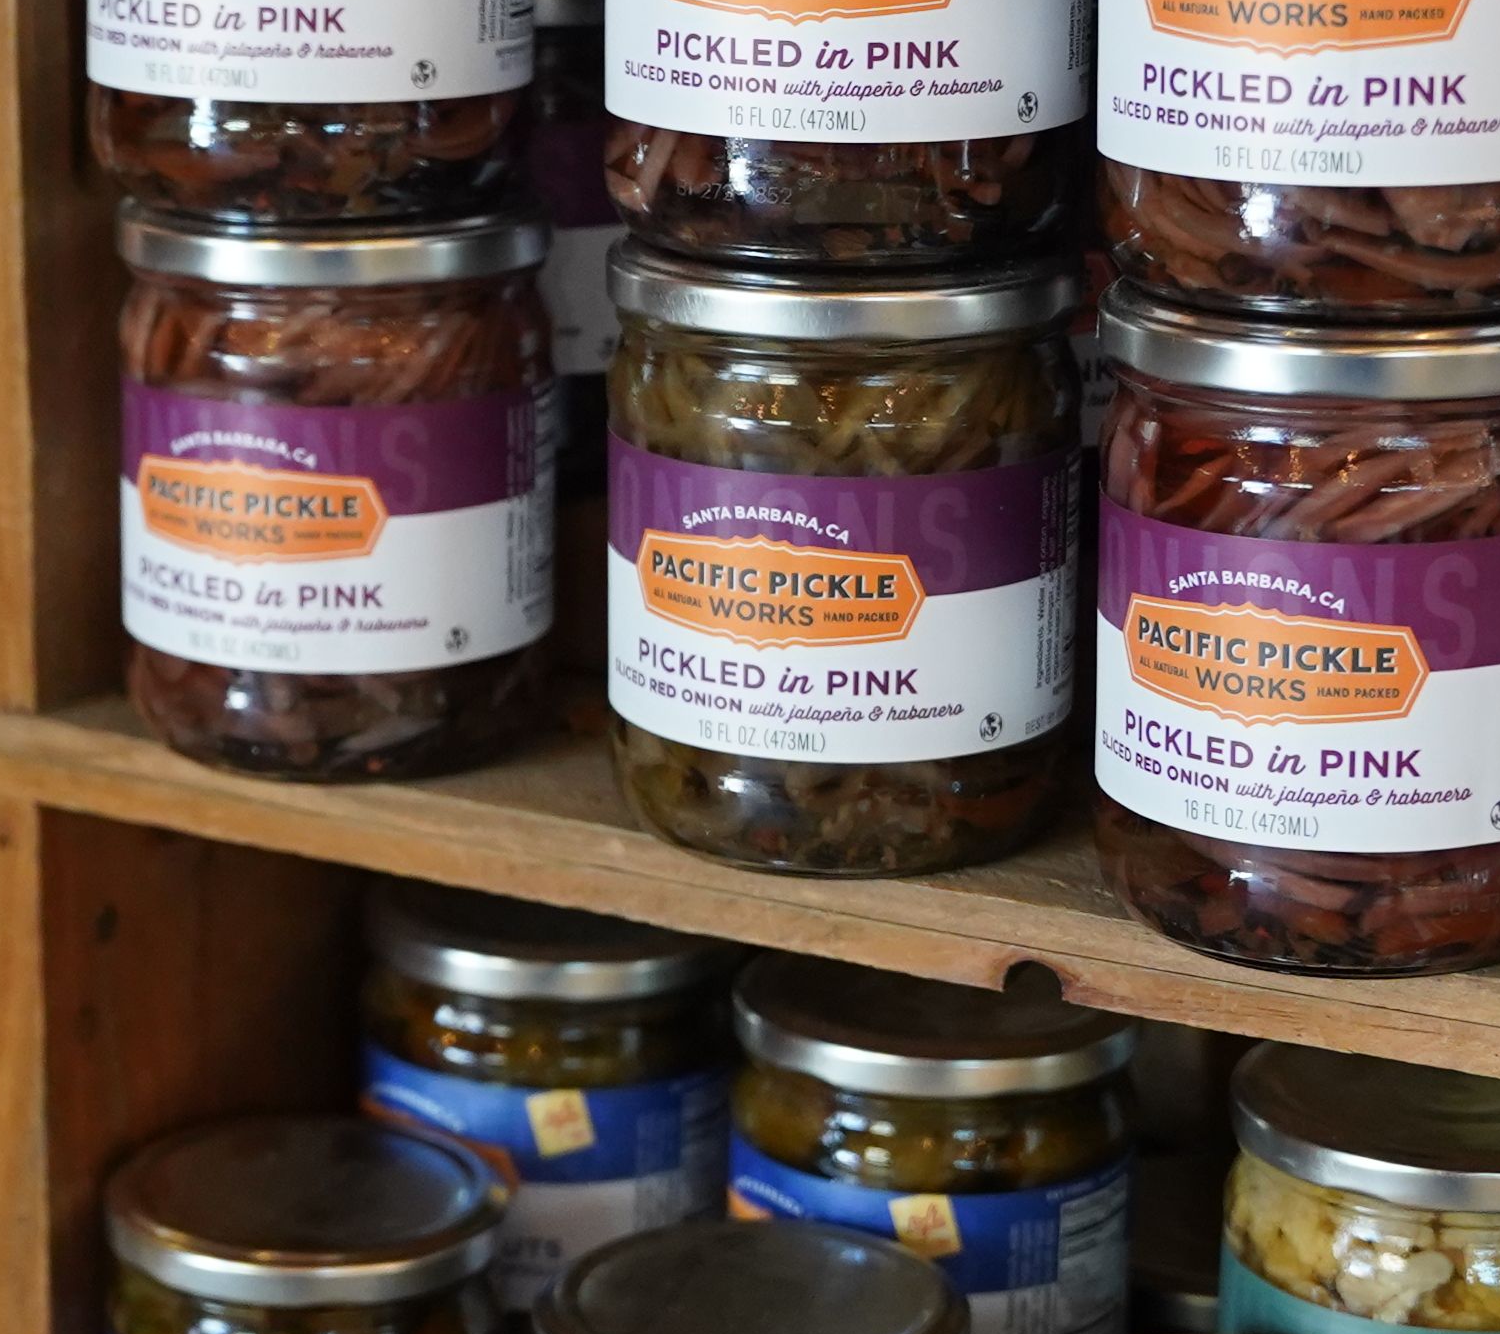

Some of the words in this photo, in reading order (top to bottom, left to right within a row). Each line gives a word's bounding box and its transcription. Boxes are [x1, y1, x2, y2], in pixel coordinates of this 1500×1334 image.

[214, 4, 246, 32] in
[257, 7, 347, 33] PINK
[1227, 0, 1348, 27] WORKS
[657, 29, 802, 67] PICKLED
[815, 41, 854, 70] in
[867, 40, 960, 70] PINK
[624, 60, 666, 83] SLICED
[670, 71, 703, 89] RED
[708, 74, 776, 94] ONION
[783, 79, 825, 97] with
[822, 80, 905, 102] jalapeño
[910, 80, 925, 96] &
[928, 76, 1004, 97] habanero
[1142, 63, 1293, 105] PICKLED
[1307, 76, 1349, 108] in
[1363, 74, 1468, 107] PINK
[727, 106, 745, 126] 16
[749, 108, 766, 127] FL
[771, 108, 797, 129] OZ.
[799, 109, 867, 132] (473ML)
[148, 474, 234, 514] PACIFIC
[244, 494, 359, 521] PICKLE
[192, 518, 286, 544] WORKS
[682, 506, 733, 530] SANTA
[825, 522, 850, 543] CA
[139, 557, 244, 602] PICKLED
[254, 581, 286, 608] in
[298, 584, 383, 608] PINK
[651, 549, 758, 592] PACIFIC
[768, 570, 896, 600] PICKLE
[1168, 571, 1220, 594] SANTA
[1318, 590, 1345, 615] CA
[708, 595, 814, 626] WORKS
[1138, 615, 1246, 666] PACIFIC
[1257, 640, 1396, 674] PICKLE
[638, 638, 766, 689] PICKLED
[777, 668, 814, 695] in
[826, 669, 919, 695] PINK
[1195, 665, 1306, 702] WORKS
[1124, 708, 1254, 768] PICKLED
[1268, 745, 1306, 775] in
[1319, 748, 1422, 778] PINK
[1101, 730, 1132, 763] SLICED
[1135, 753, 1163, 776] RED
[1166, 764, 1230, 793] ONION
[1235, 781, 1275, 803] with
[1271, 786, 1360, 808] jalapeño
[1365, 788, 1381, 806] &
[1384, 786, 1473, 805] habanero
